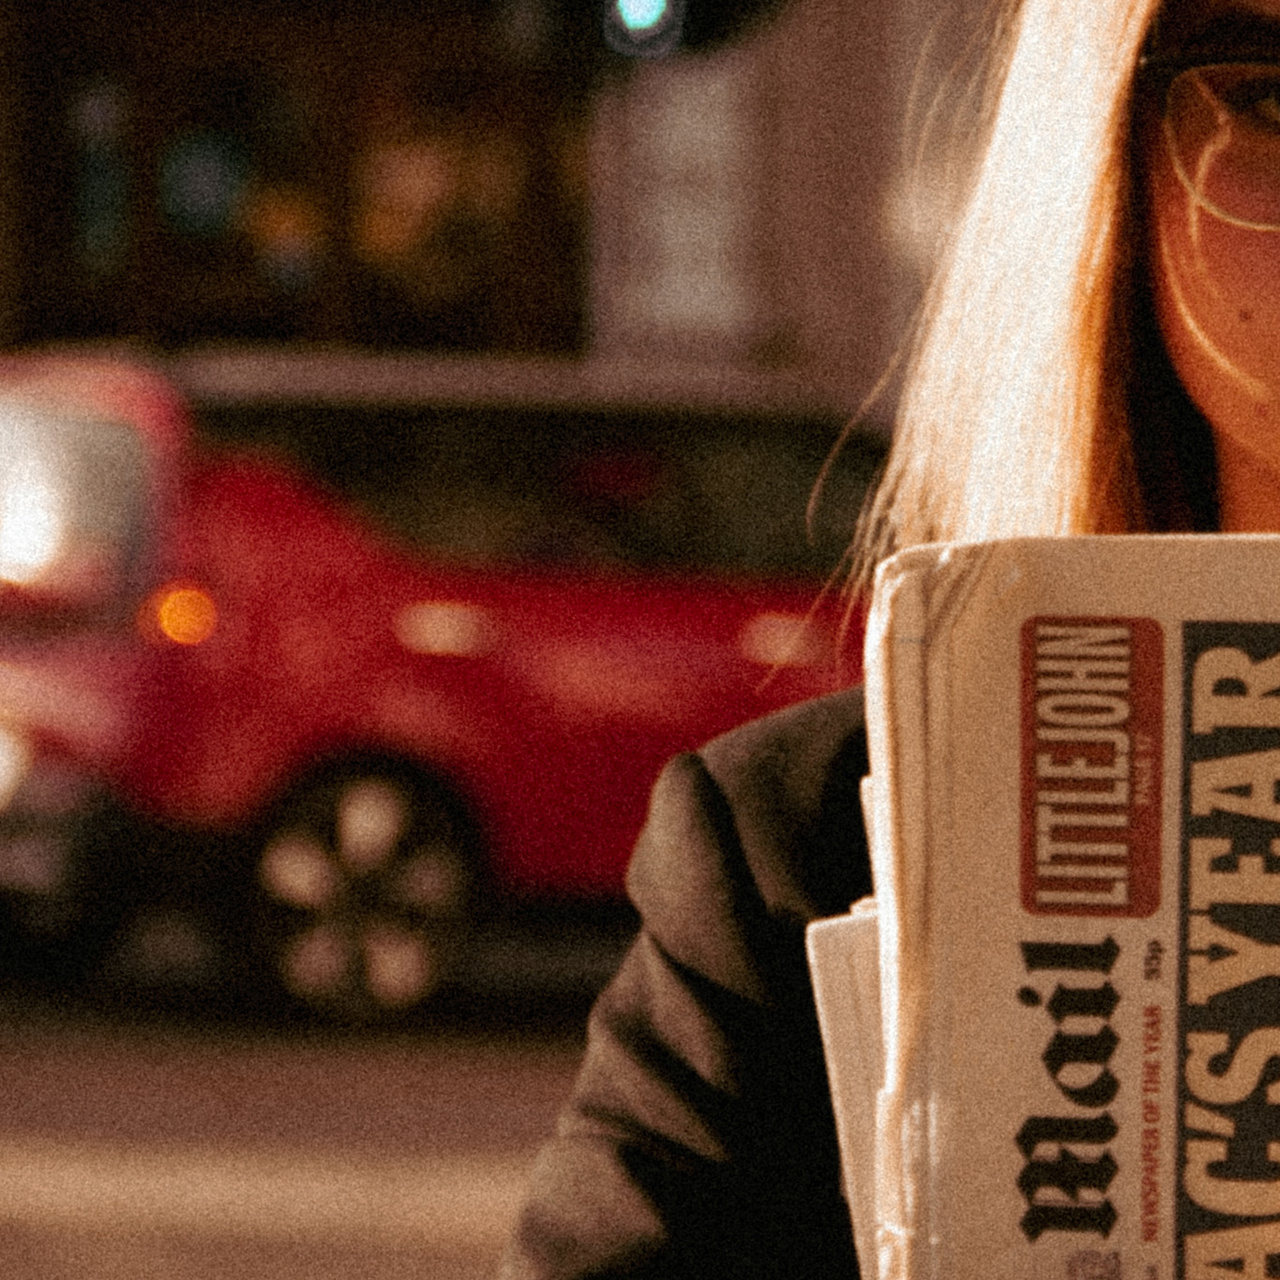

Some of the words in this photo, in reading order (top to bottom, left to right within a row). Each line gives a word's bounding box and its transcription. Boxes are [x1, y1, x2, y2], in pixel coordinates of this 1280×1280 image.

[1036, 625, 1129, 906] LITTLEJOHN
[1133, 757, 1154, 807] PAGE
[1142, 1004, 1162, 1056] YEAR
[1014, 935, 1121, 1243] Mail
[1142, 1059, 1161, 1095] THE
[1141, 1098, 1161, 1125] OF
[1141, 1127, 1160, 1243] NEWSPAPER
